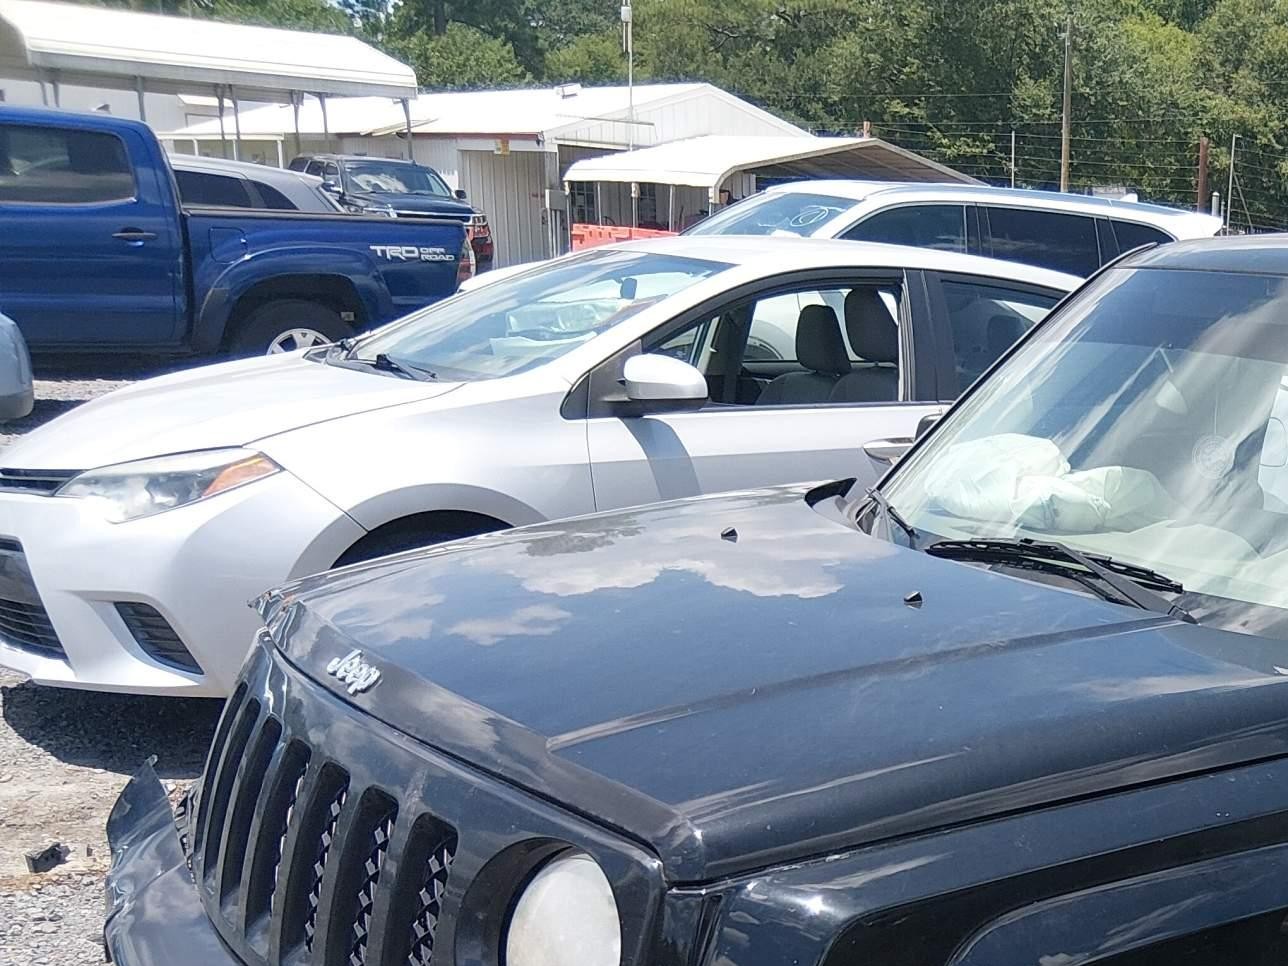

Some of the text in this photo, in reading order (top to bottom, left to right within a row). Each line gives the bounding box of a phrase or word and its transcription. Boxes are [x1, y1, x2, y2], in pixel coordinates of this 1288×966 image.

[369, 245, 446, 261] TRD OFF
[420, 254, 455, 262] ROAD
[326, 649, 381, 695] Jeep
